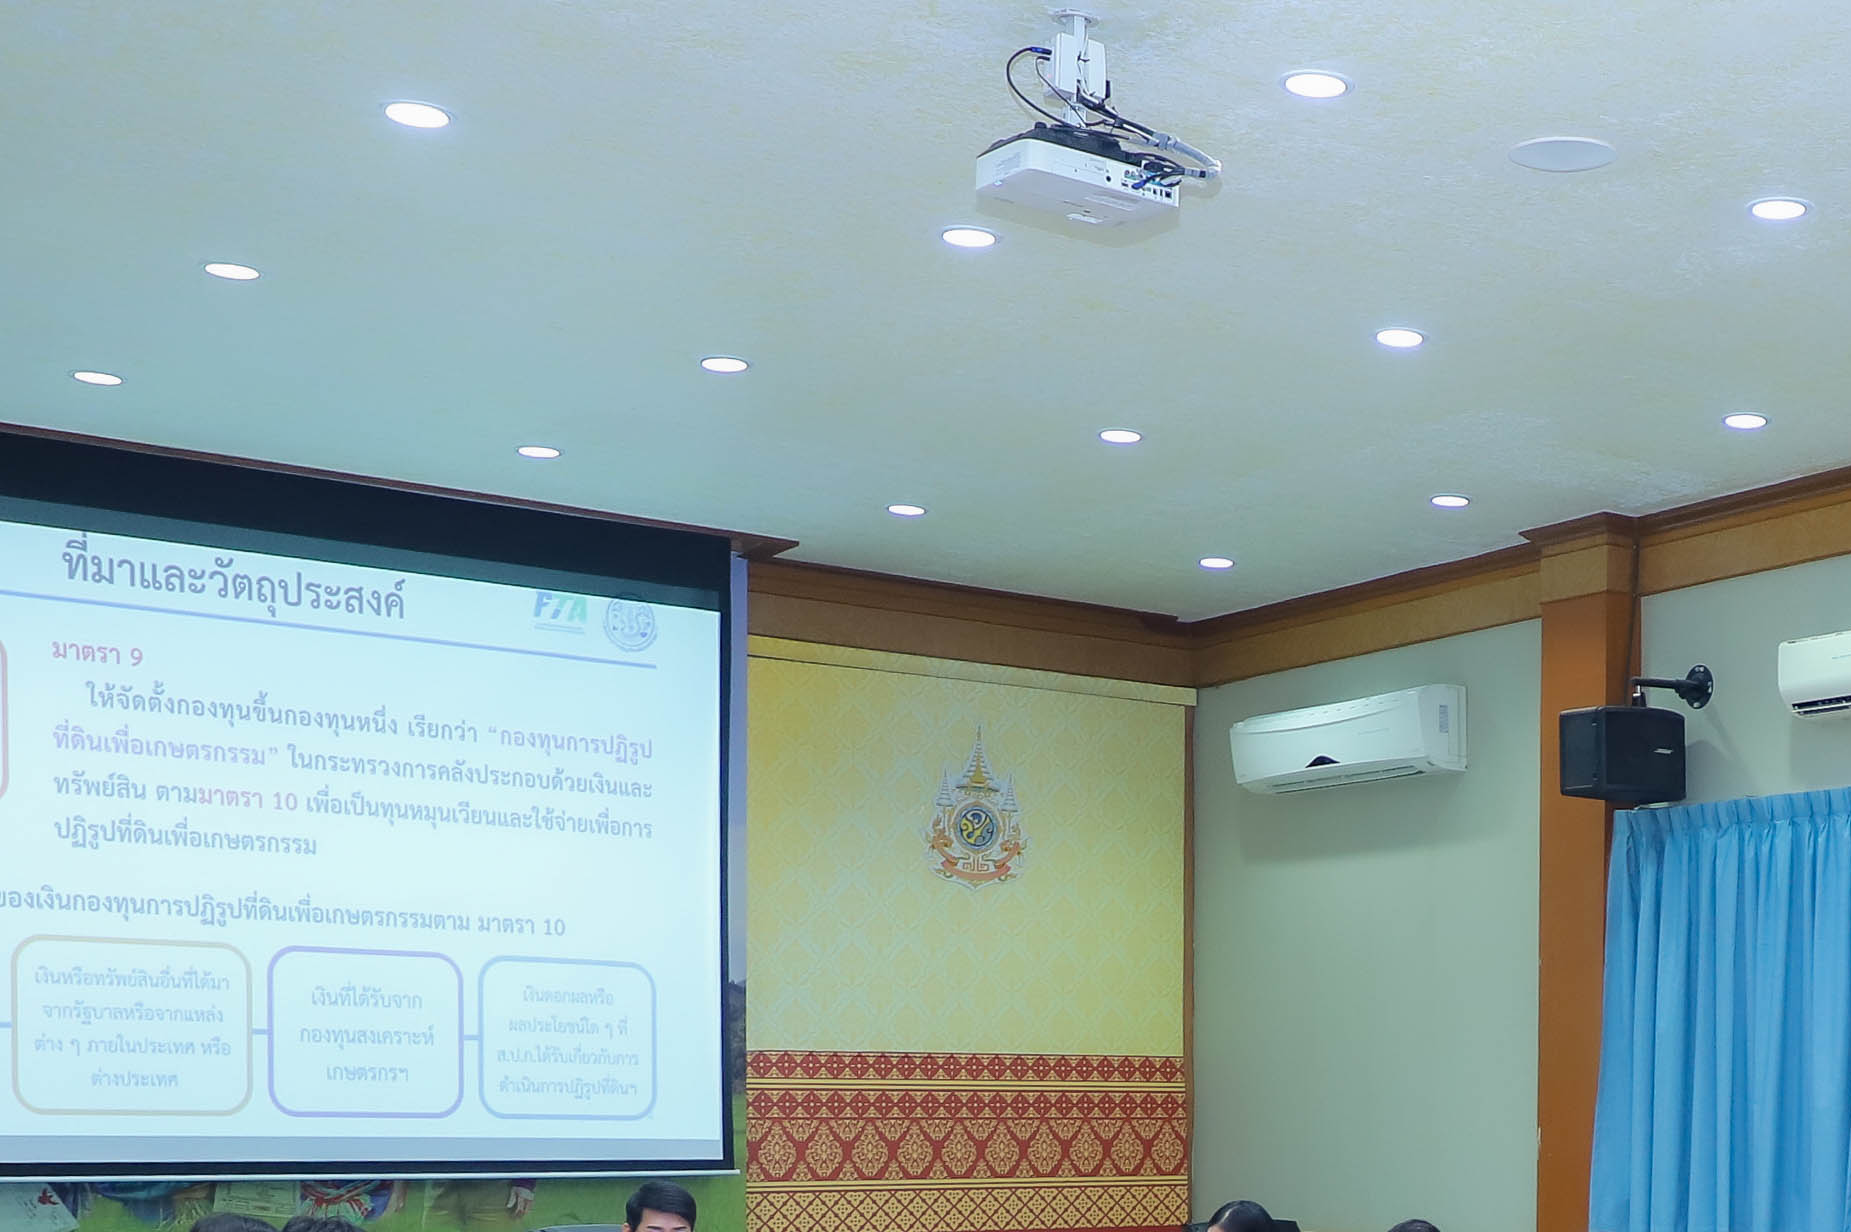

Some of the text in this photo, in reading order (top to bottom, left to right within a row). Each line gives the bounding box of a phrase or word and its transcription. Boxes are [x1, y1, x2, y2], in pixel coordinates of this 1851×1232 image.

[62, 533, 406, 619] ที่มาและวัตถุประสงค์
[52, 640, 144, 667] มาตรา 9
[85, 680, 398, 737] ให้จัดตั้งกองทุนขึ้นกองทุนหนึ่ง
[407, 714, 478, 743] เรียกว่า
[53, 770, 147, 800] ทรัพย์สิน
[273, 792, 298, 811] 10
[53, 812, 318, 856] ปฏิรูปที่ดินเพื่อเกษตรกรรม
[478, 914, 536, 935] มาตรา
[544, 918, 566, 936] 10
[311, 982, 423, 1010] เงินที่ได้รับจาก
[300, 1025, 434, 1051] กองทุนสงเคราะห์
